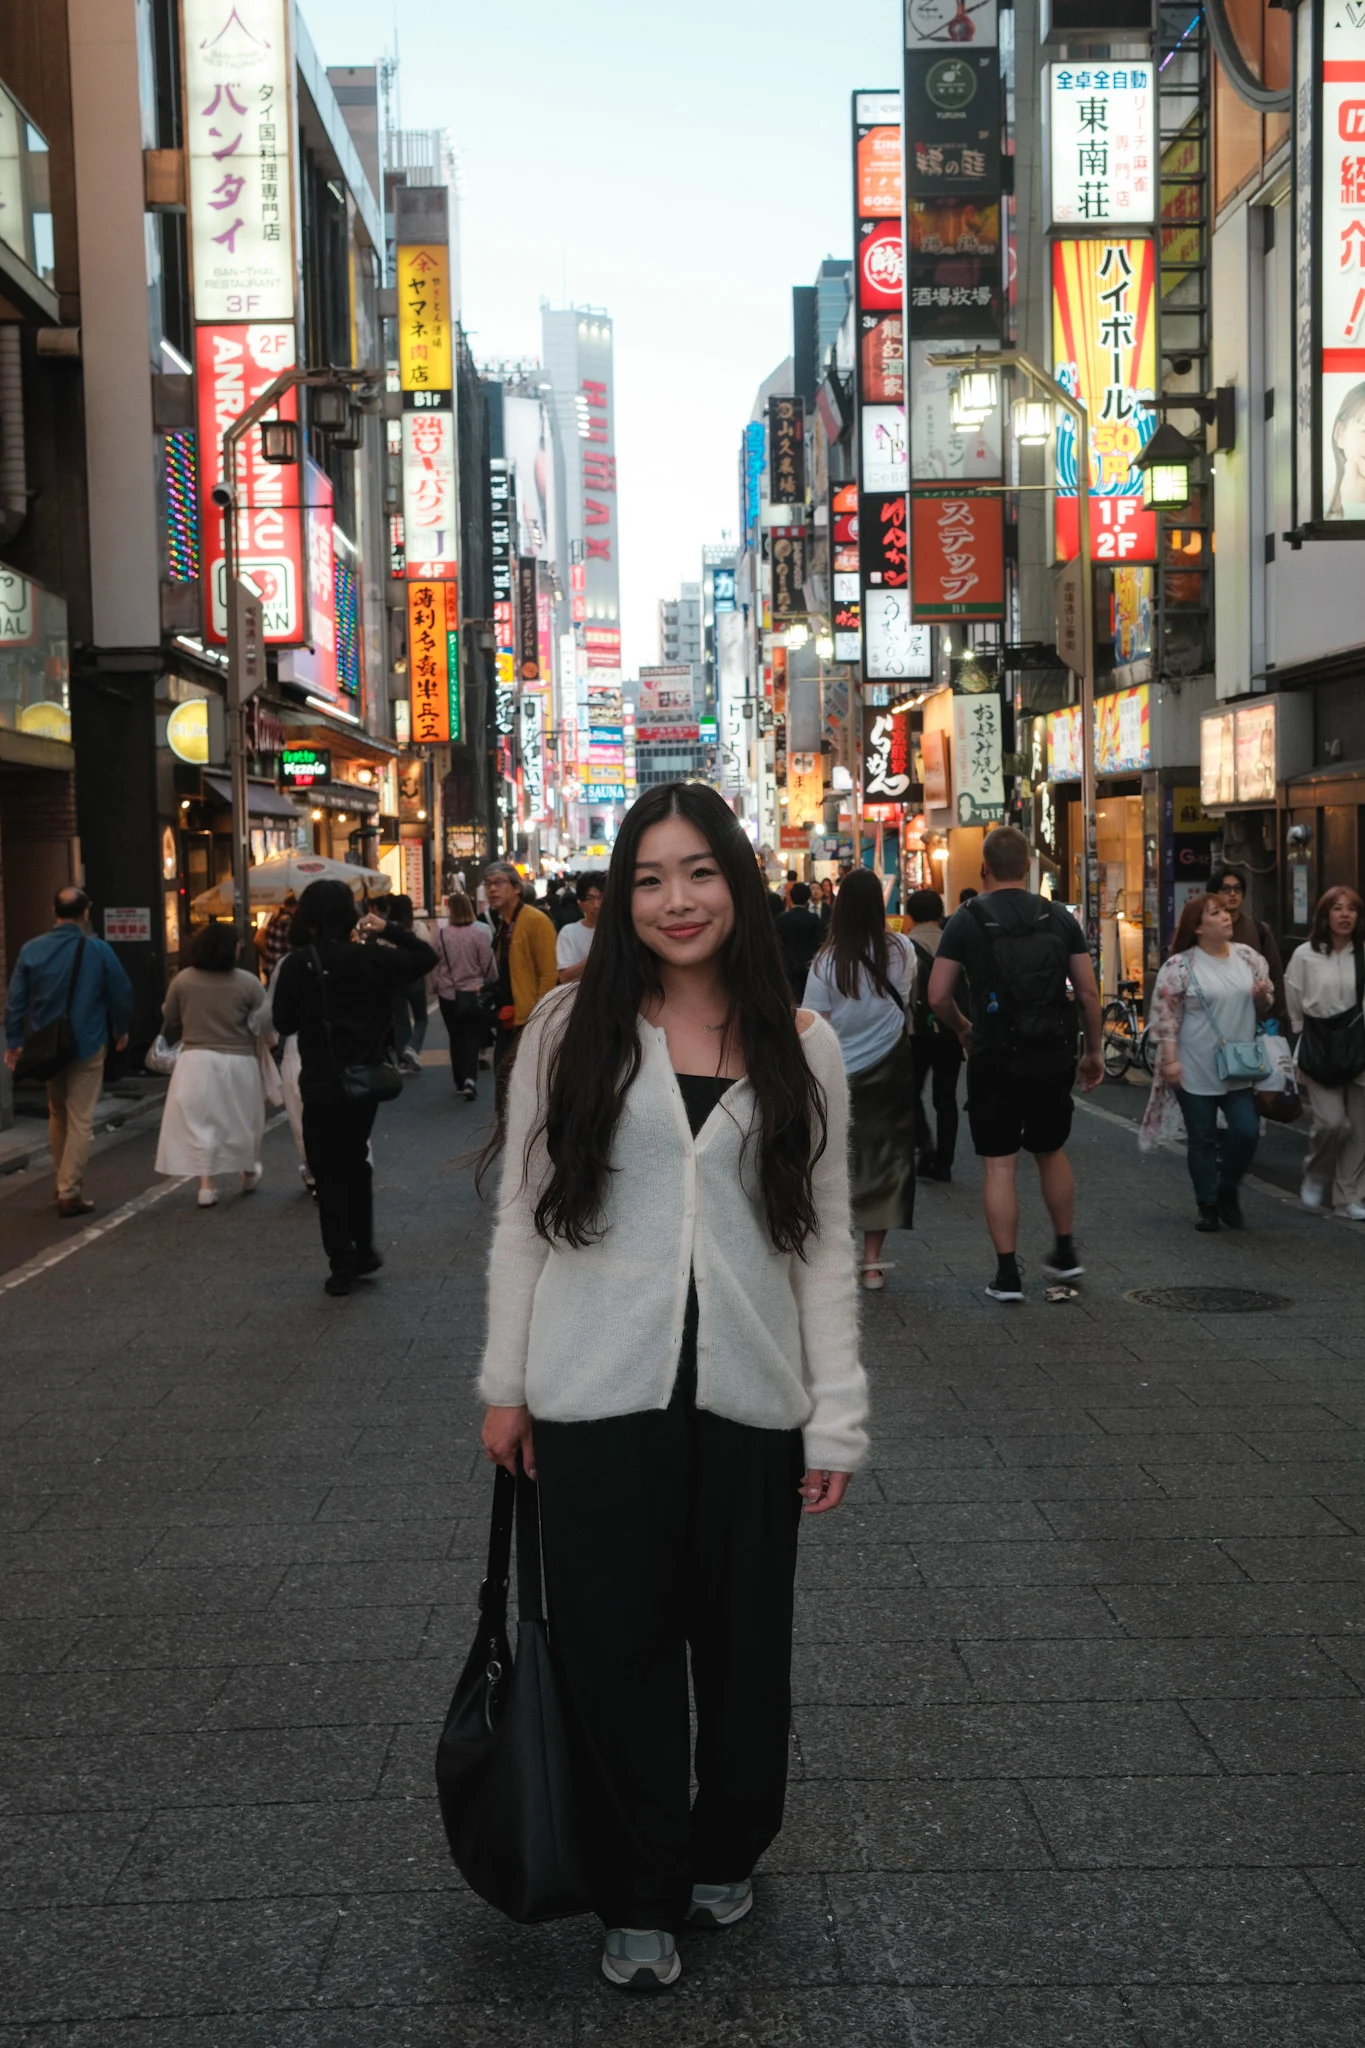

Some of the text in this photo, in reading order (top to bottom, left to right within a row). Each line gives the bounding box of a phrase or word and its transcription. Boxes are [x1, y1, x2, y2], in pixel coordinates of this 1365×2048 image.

[1056, 70, 1148, 90] 全卓全自動
[1133, 95, 1148, 193] リーチ麻雀
[201, 83, 248, 254] バンタイ
[258, 83, 280, 242] タイ国料理専門店
[1076, 96, 1110, 219] 東南荘
[1115, 135, 1130, 207] 専門店
[1056, 205, 1072, 220] 3F
[205, 278, 281, 289] RESTAURANT
[911, 286, 992, 307] 酒場牧場
[227, 295, 261, 313] 3F
[259, 334, 288, 355] 2F
[408, 278, 429, 385] ヤマネ肉店
[1099, 247, 1134, 420] ハイボール
[413, 391, 441, 408] B1F
[1102, 455, 1129, 484] 円
[1098, 499, 1137, 525] 1F
[936, 500, 979, 601] ステップ
[1096, 532, 1138, 559] 2F
[418, 561, 445, 578] 4F
[0, 616, 27, 635] AL
[969, 703, 1000, 794] お好み焼き
[588, 785, 625, 799] SAUNA
[980, 807, 1004, 821] B1F
